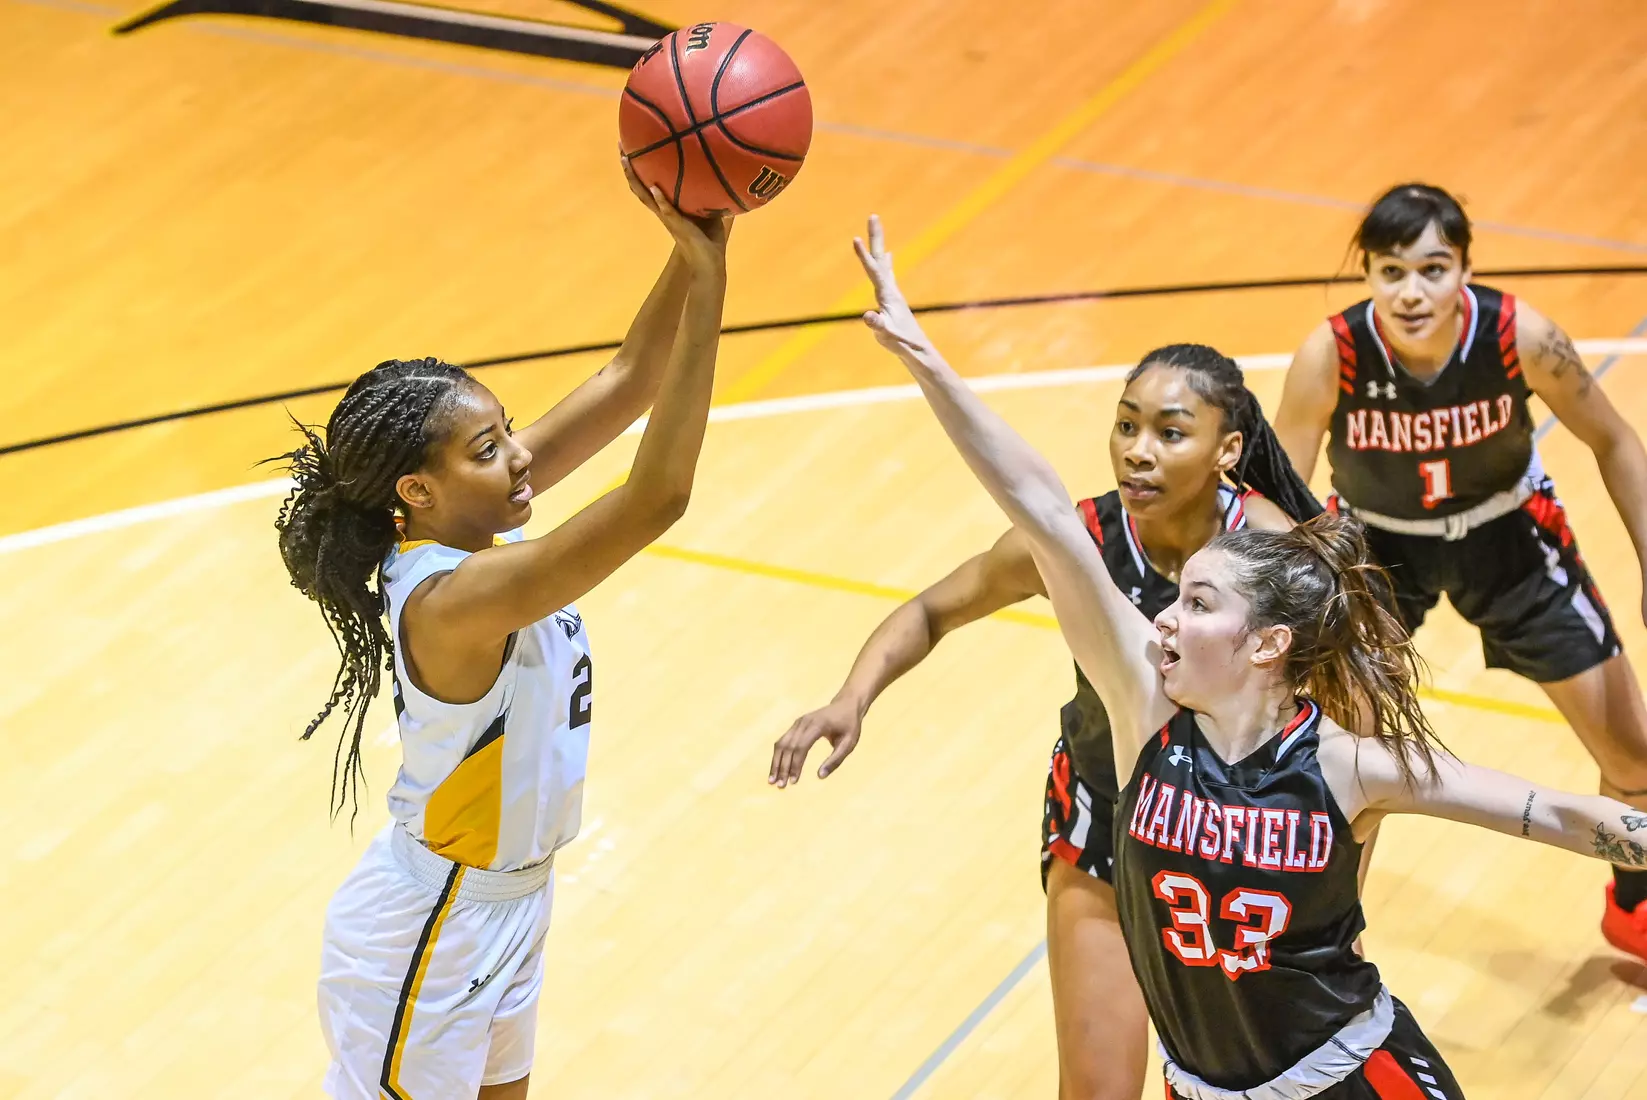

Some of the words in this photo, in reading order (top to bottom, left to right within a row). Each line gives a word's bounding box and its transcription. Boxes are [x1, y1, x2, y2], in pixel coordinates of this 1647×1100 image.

[686, 22, 717, 56] on
[1346, 394, 1512, 452] MANSFIELD
[1418, 458, 1455, 509] 1
[569, 652, 593, 731] 2
[1128, 772, 1333, 872] MANSFIELD
[1151, 869, 1292, 981] 33
